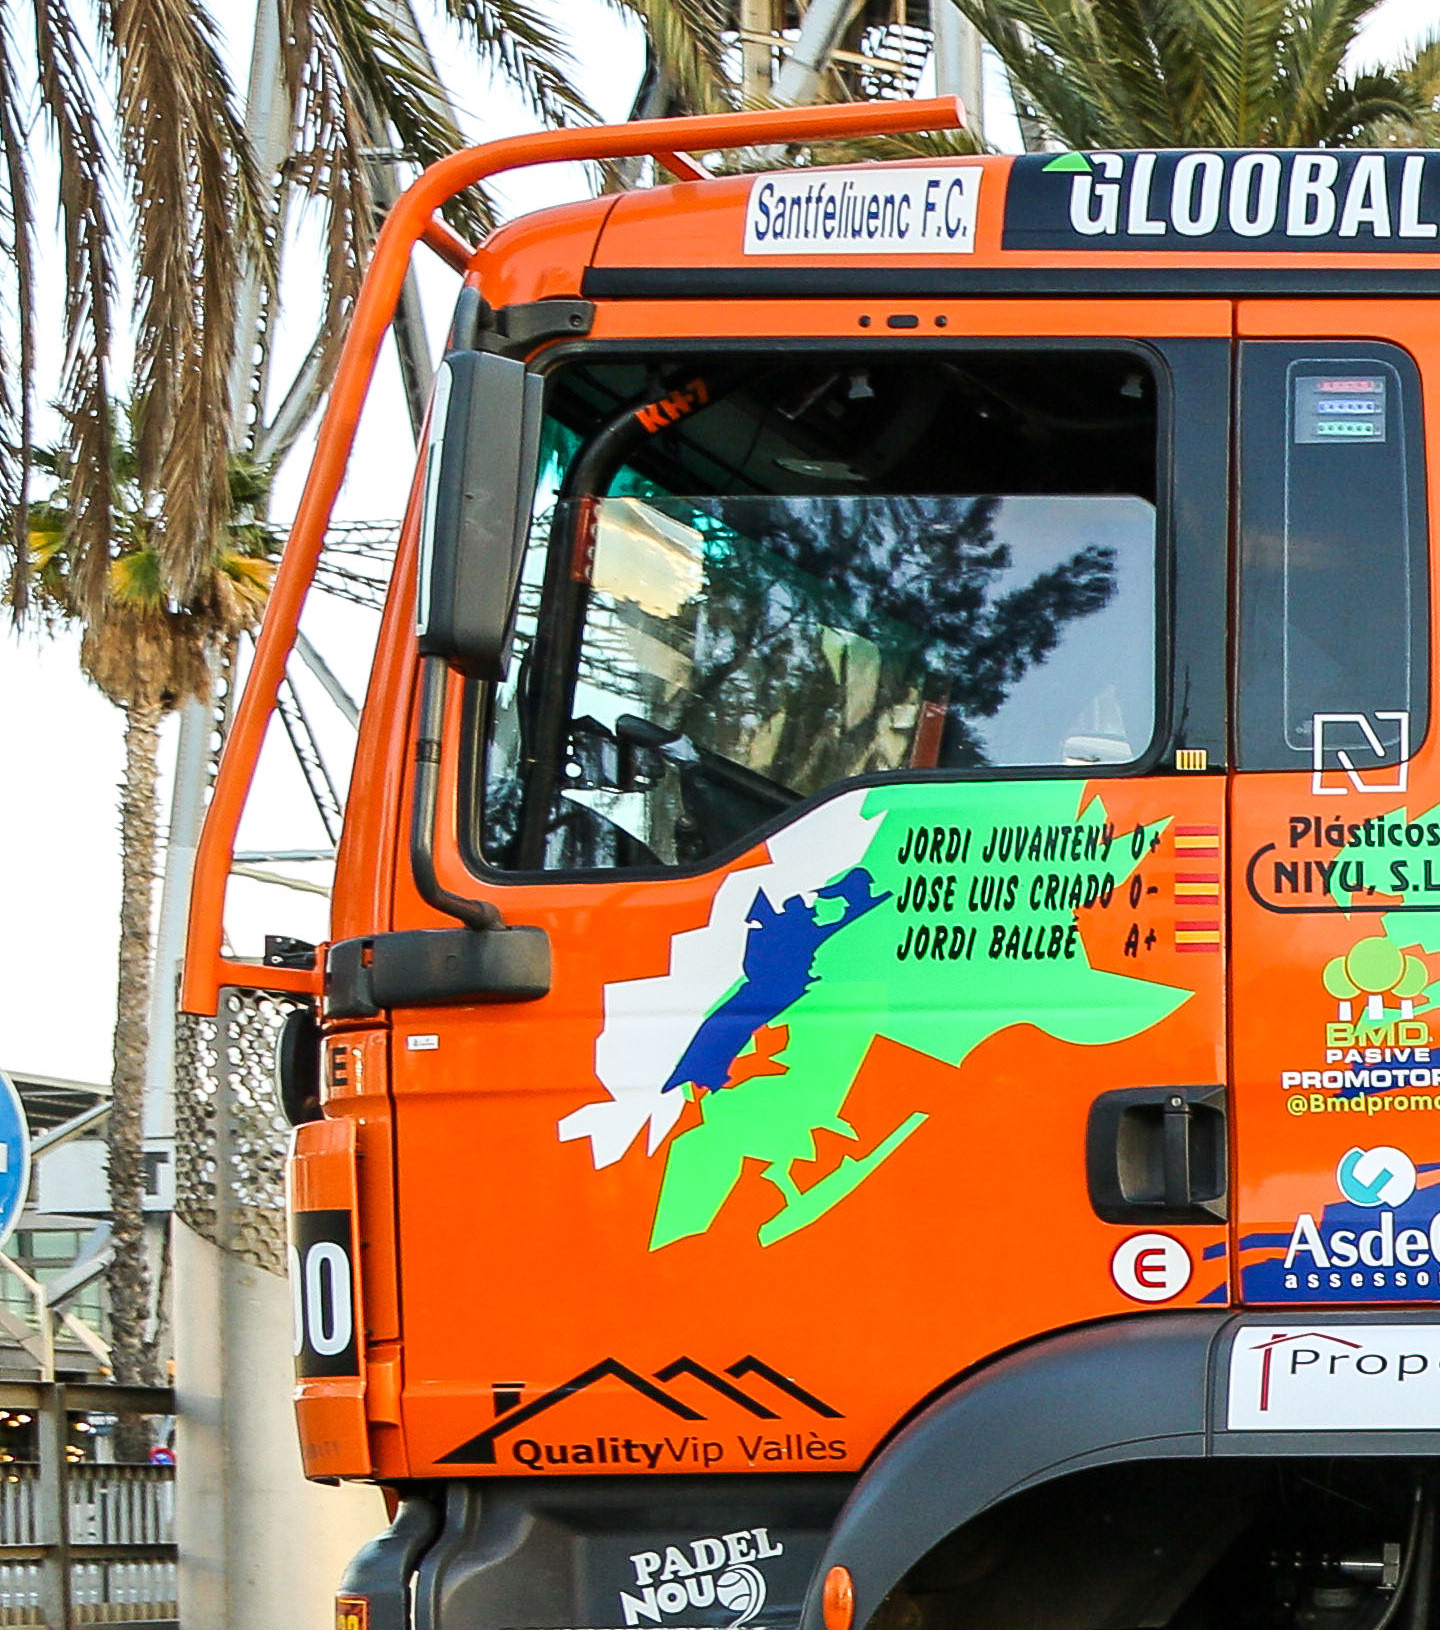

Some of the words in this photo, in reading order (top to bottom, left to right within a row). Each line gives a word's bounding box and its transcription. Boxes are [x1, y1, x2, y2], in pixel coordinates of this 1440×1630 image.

[754, 177, 911, 242] Santfeliuenc
[924, 176, 968, 238] F.C.
[1069, 152, 1439, 239] GLOOBAL
[897, 826, 972, 865] JORDI
[981, 823, 1115, 863] JUVANTENY
[1288, 815, 1440, 850] Plásticos
[896, 874, 957, 913] JOSE
[968, 874, 1019, 913] LUIS
[1029, 872, 1115, 911] CRIADO
[1273, 861, 1376, 898] NIYU,
[896, 924, 977, 961] JORDI
[988, 914, 1080, 960] BALLBÉ
[1123, 922, 1157, 958] A+
[1325, 1021, 1430, 1048] BMD
[1326, 1048, 1432, 1064] PASIVE
[737, 1431, 848, 1462] Vallès
[629, 1527, 784, 1587] PADEL
[619, 1571, 719, 1626] NOU
